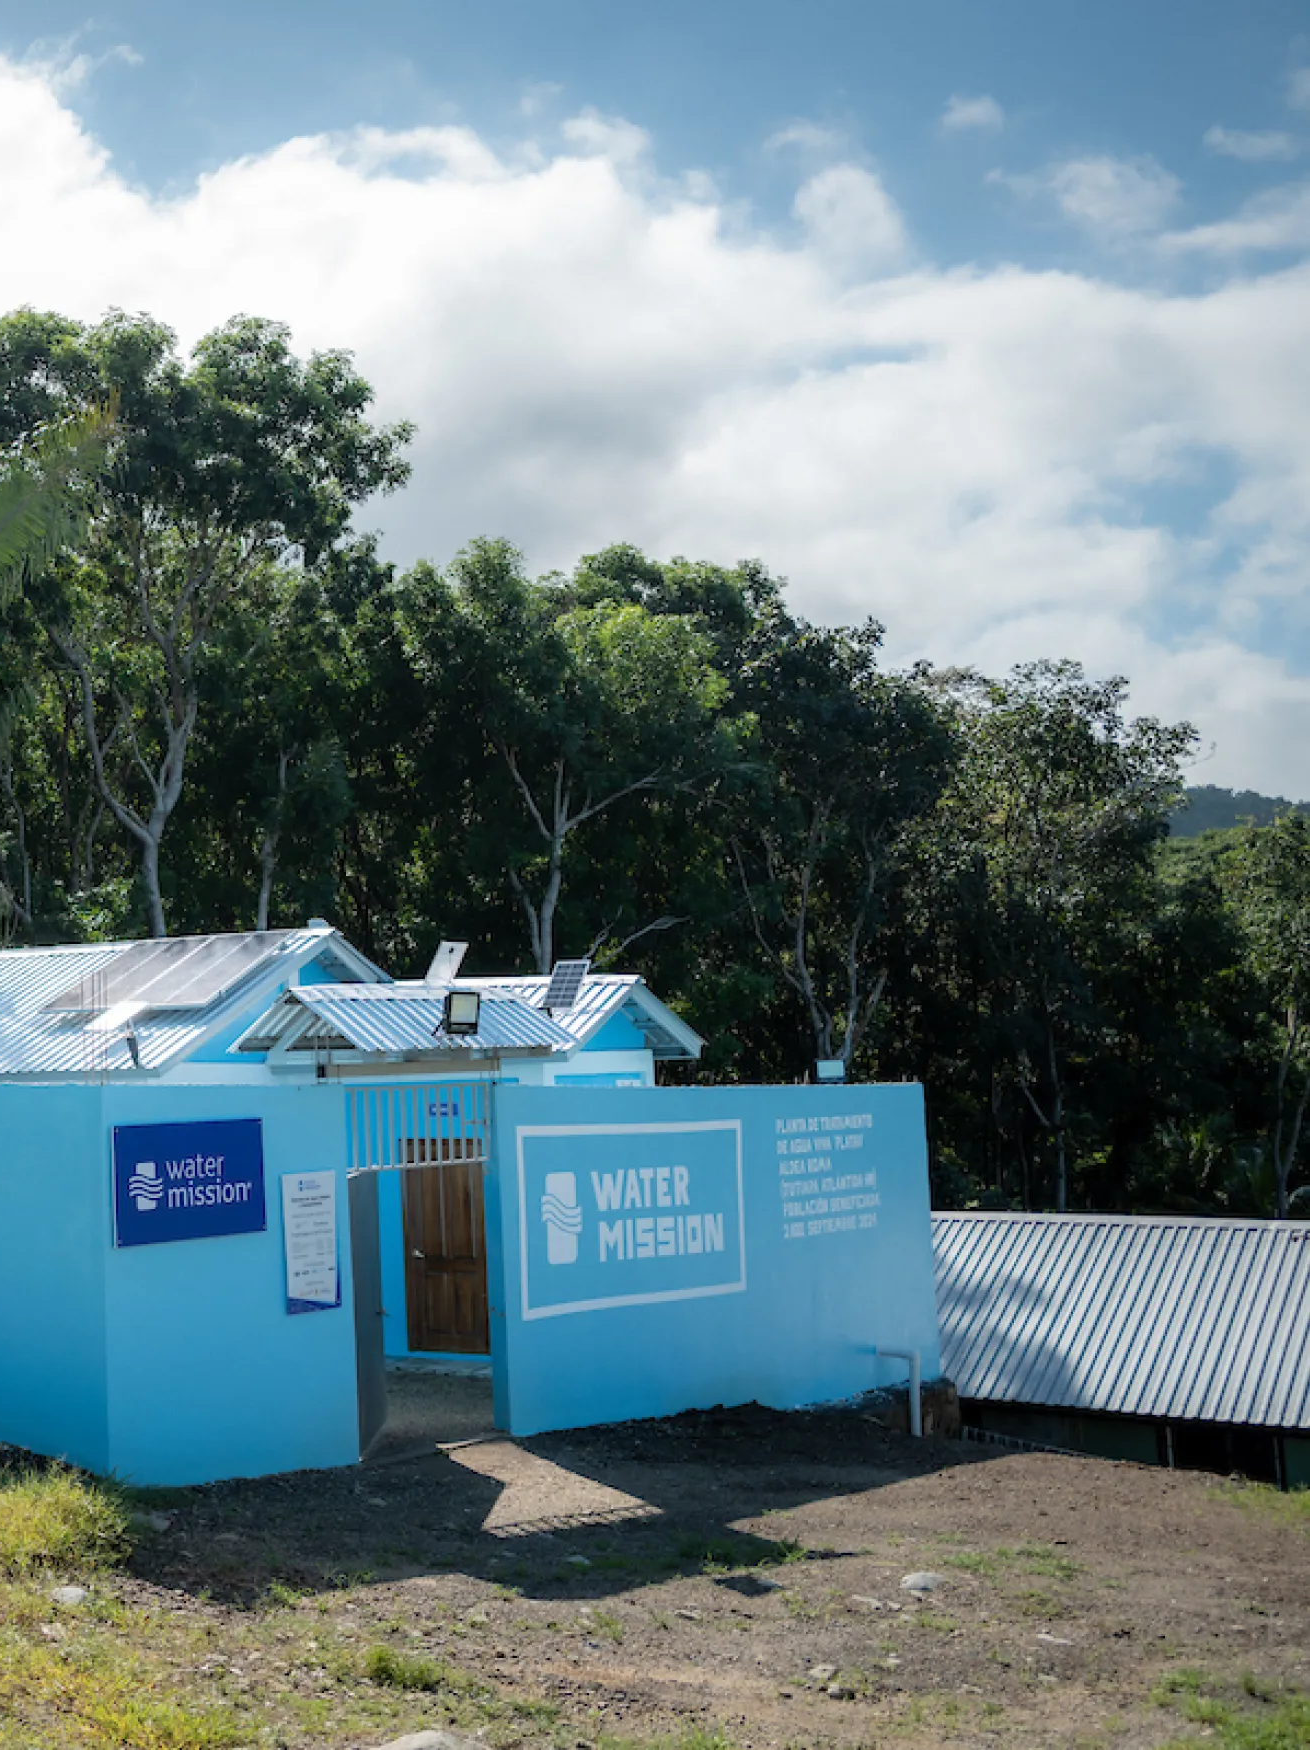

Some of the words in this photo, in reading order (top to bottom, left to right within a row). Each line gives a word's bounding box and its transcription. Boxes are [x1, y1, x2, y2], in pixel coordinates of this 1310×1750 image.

[165, 1153, 225, 1180] water
[590, 1165, 691, 1212] WATER
[598, 1212, 725, 1263] MISSION
